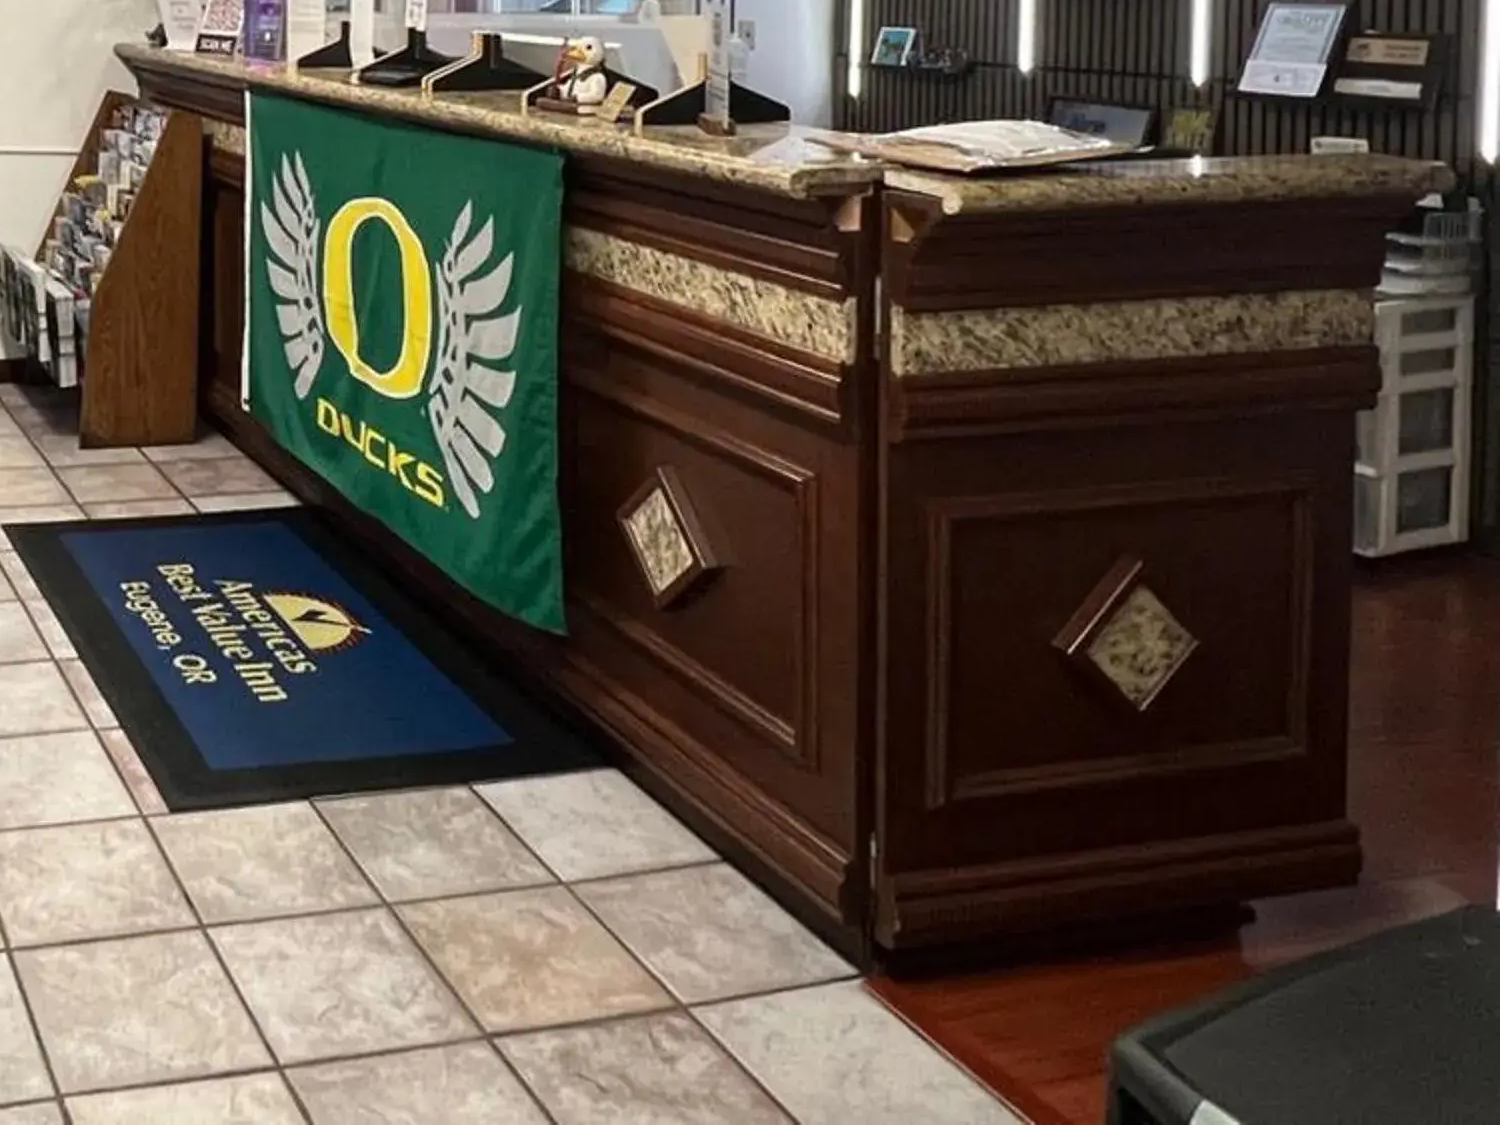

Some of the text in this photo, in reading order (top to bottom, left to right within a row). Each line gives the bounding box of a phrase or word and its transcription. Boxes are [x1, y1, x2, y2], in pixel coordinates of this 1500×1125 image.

[323, 196, 432, 399] O
[316, 397, 444, 507] DUCKS
[119, 580, 217, 684] Eugene, OR
[156, 563, 288, 702] Best Value Inn
[213, 579, 317, 674] Americas
